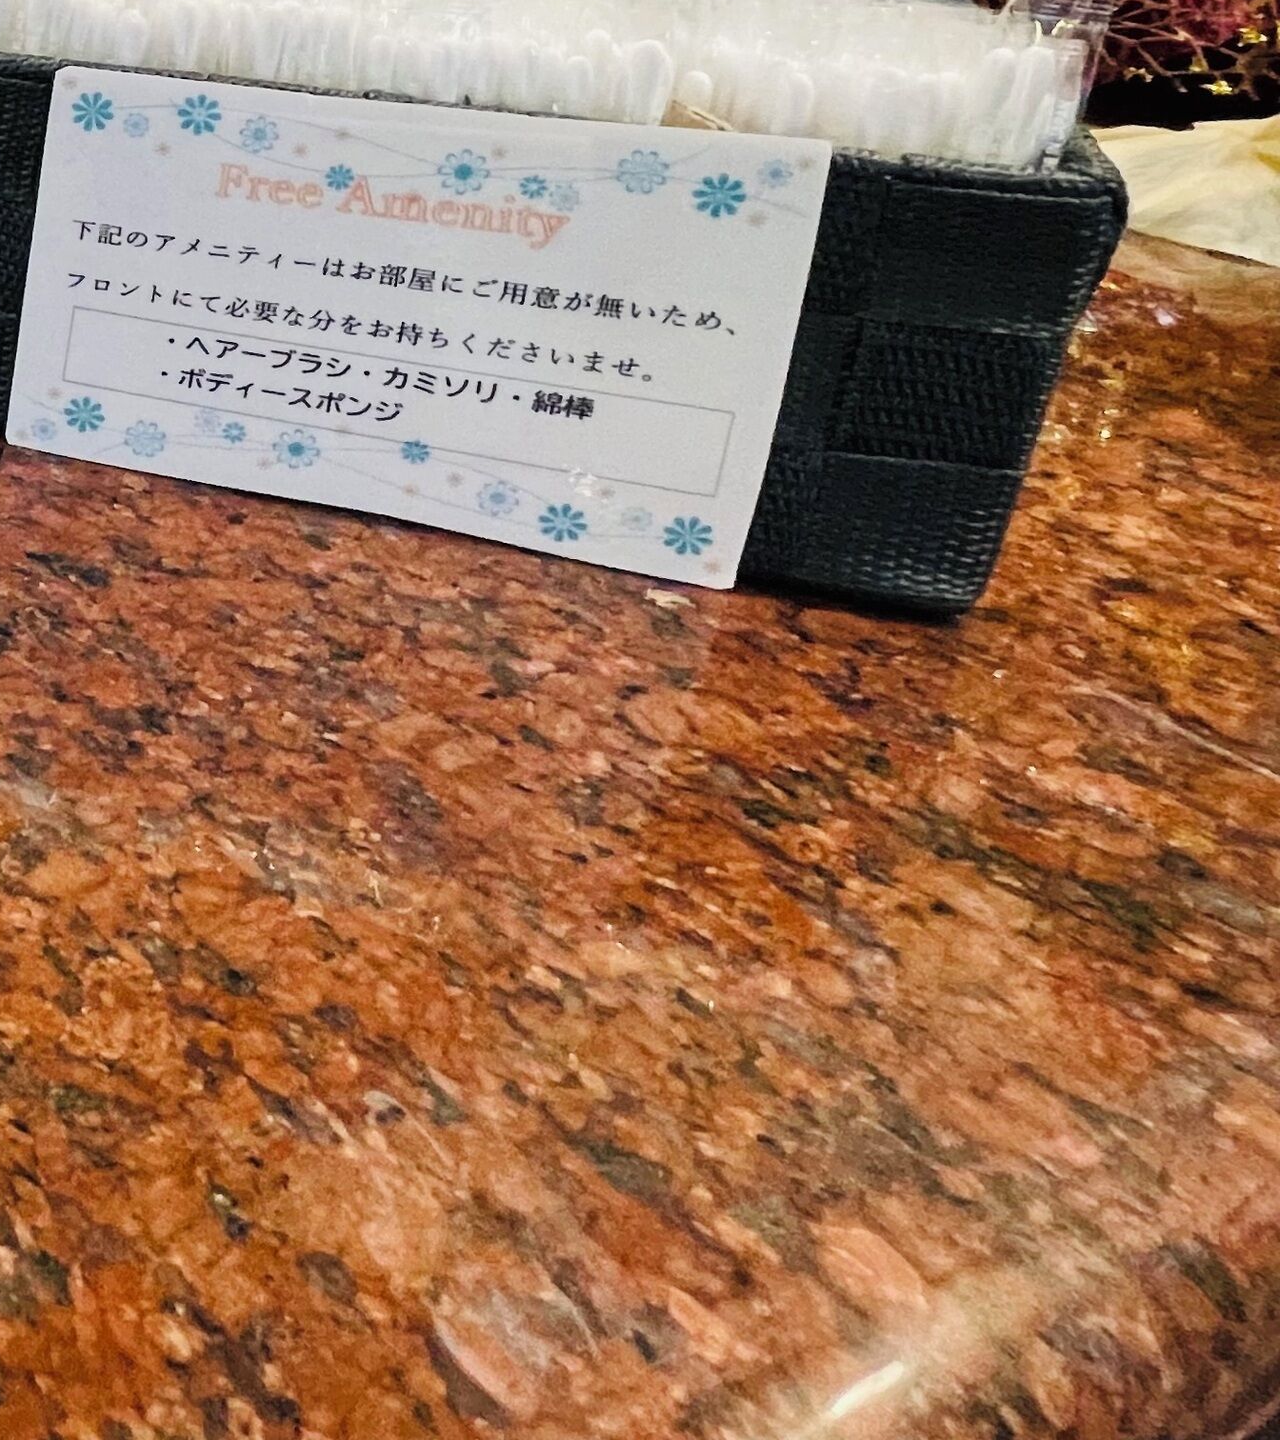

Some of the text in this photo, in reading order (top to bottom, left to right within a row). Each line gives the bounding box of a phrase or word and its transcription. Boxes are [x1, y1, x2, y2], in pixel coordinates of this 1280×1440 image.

[215, 162, 571, 250] Free Amenity
[67, 273, 652, 383] フロントにて必要な分をお持ちくださいませ。
[72, 219, 736, 336] 下記のアメニティーはお部屋にご用意が無いため、
